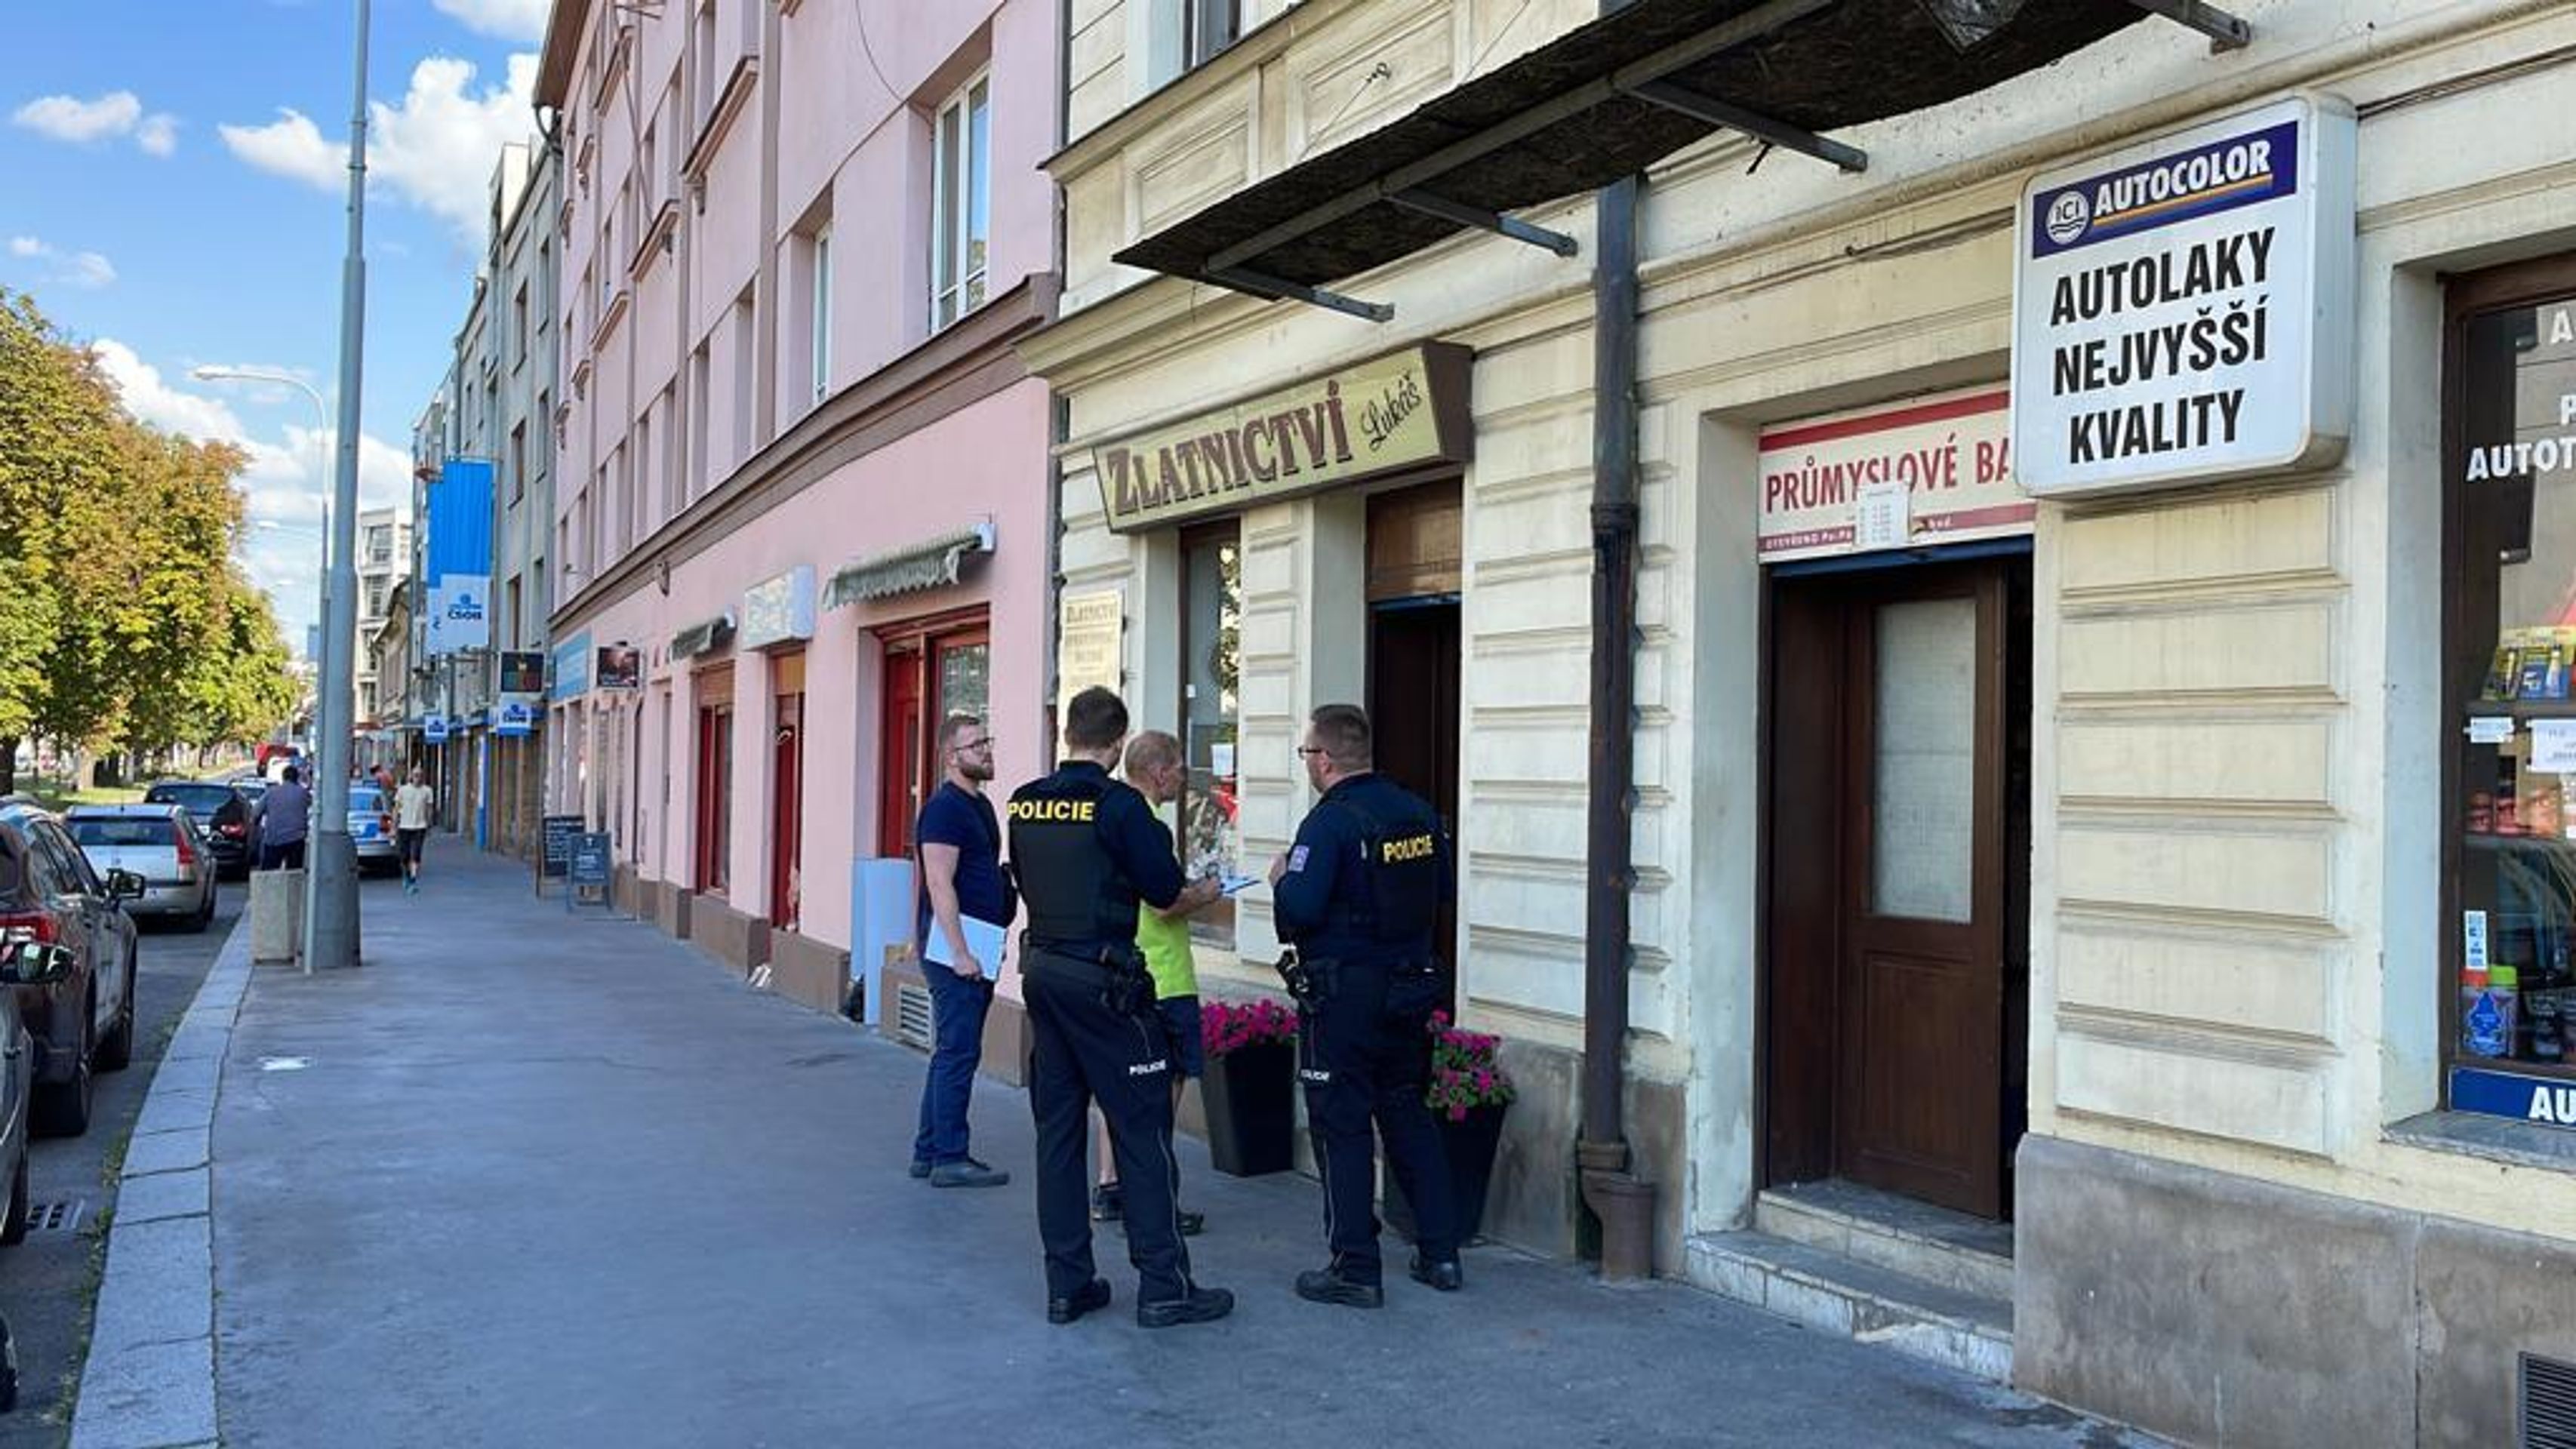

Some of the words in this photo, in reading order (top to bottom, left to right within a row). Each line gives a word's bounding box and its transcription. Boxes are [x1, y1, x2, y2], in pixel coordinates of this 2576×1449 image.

[2093, 140, 2271, 217] AUTOCOLOR
[2050, 227, 2276, 327] AUTOLAKY
[2053, 294, 2268, 396] NEJVYŠŠÍ
[1361, 371, 1423, 451] Lukáš
[2070, 389, 2245, 463] KVALITY
[2466, 436, 2576, 481] AUTOT
[1007, 801, 1095, 821] POLICIE
[1383, 835, 1433, 863] POLICIE
